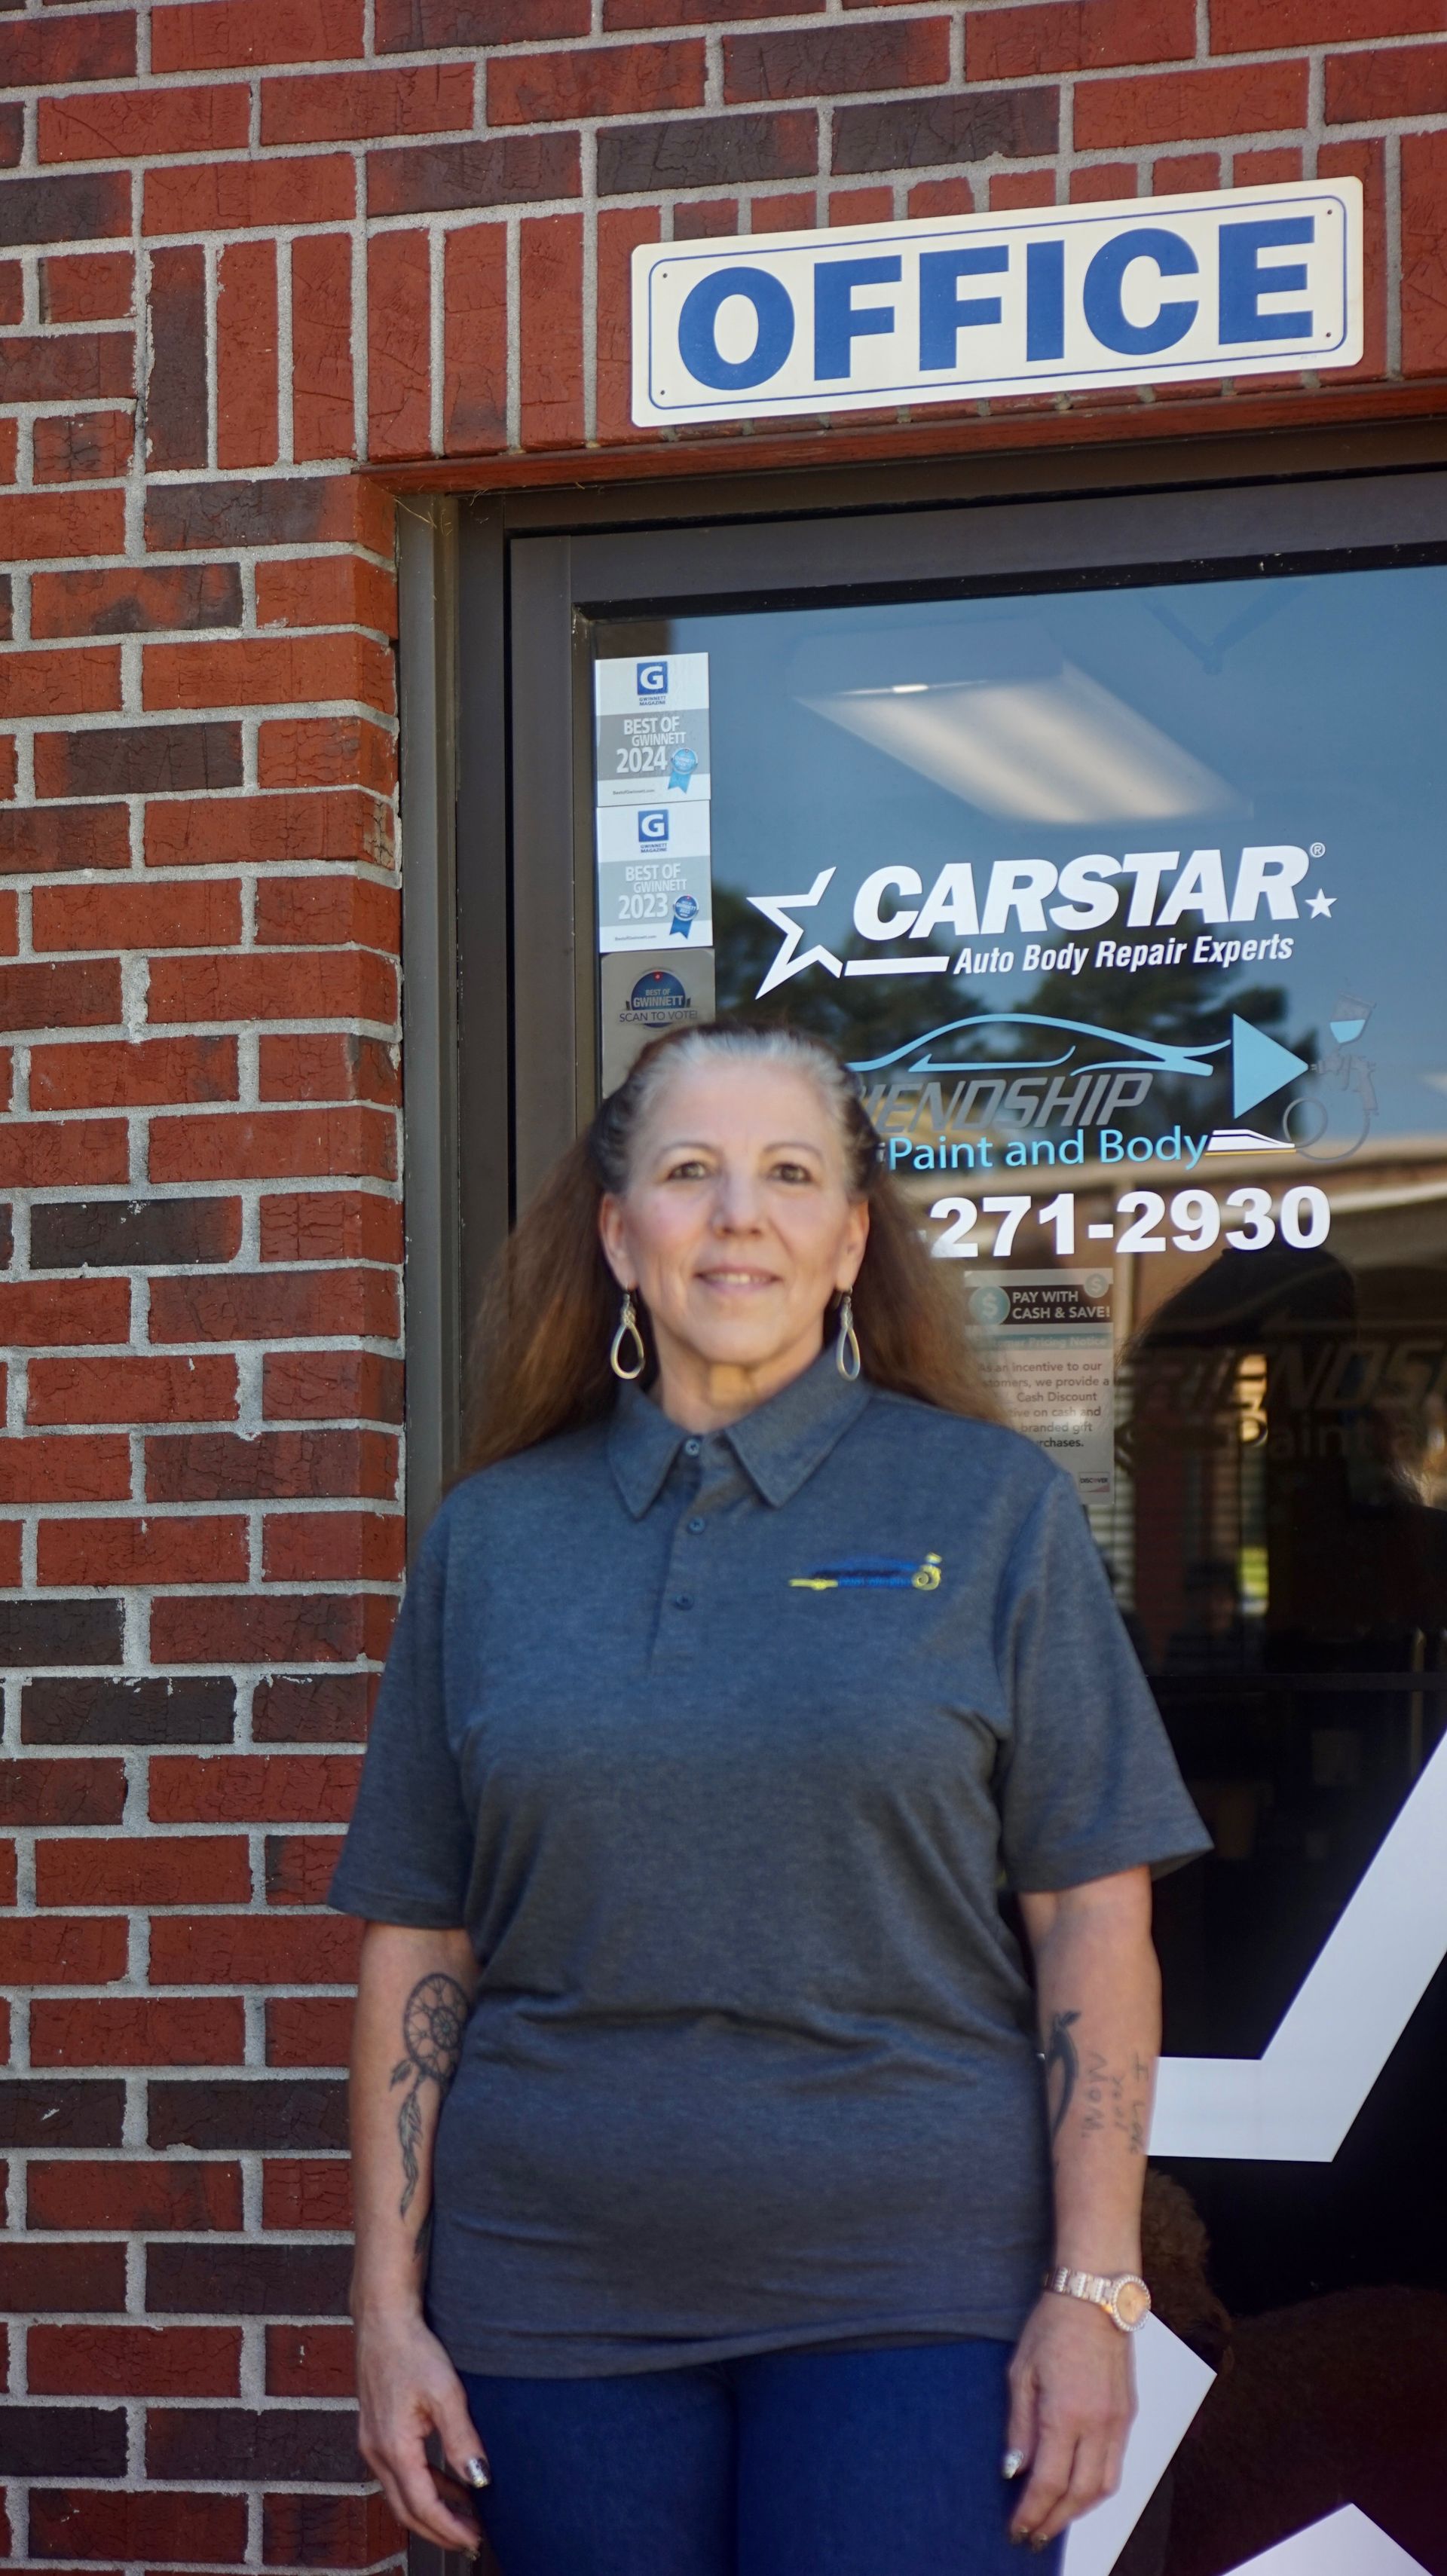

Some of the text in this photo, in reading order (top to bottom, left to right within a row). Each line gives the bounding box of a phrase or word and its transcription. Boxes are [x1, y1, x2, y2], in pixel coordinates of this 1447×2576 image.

[677, 215, 1315, 391] OFFICE
[640, 666, 664, 690] G
[624, 717, 680, 735] BEST OF
[632, 732, 687, 747] GWINNETT
[616, 746, 668, 773] 2024
[641, 814, 665, 837] G
[626, 863, 681, 882] BEST OF
[634, 879, 687, 894] GWINNETT
[618, 893, 668, 920] 2023
[953, 934, 1294, 975] Auto Body Repair Experts
[633, 995, 684, 1007] GWINNETT
[619, 1010, 698, 1023] SCAN TO VOTE!
[859, 1072, 1155, 1134] IENDSHIP
[889, 1126, 1208, 1171] Paint and Body
[1012, 1291, 1078, 1303] PAY WITH
[1012, 1306, 1110, 1319] CASH & SAVE!
[1029, 1337, 1066, 1347] Pricing
[1070, 1336, 1106, 1346] Notice
[1012, 1362, 1064, 1372] incentive
[1067, 1362, 1079, 1371] to
[982, 1378, 1032, 1388] stomers,
[1056, 1376, 1099, 1389] provide
[1017, 1391, 1097, 1403] Cash Discount
[1033, 1409, 1048, 1417] on
[1051, 1407, 1077, 1417] cash
[1080, 1407, 1102, 1416] and
[1020, 1422, 1069, 1432] branded
